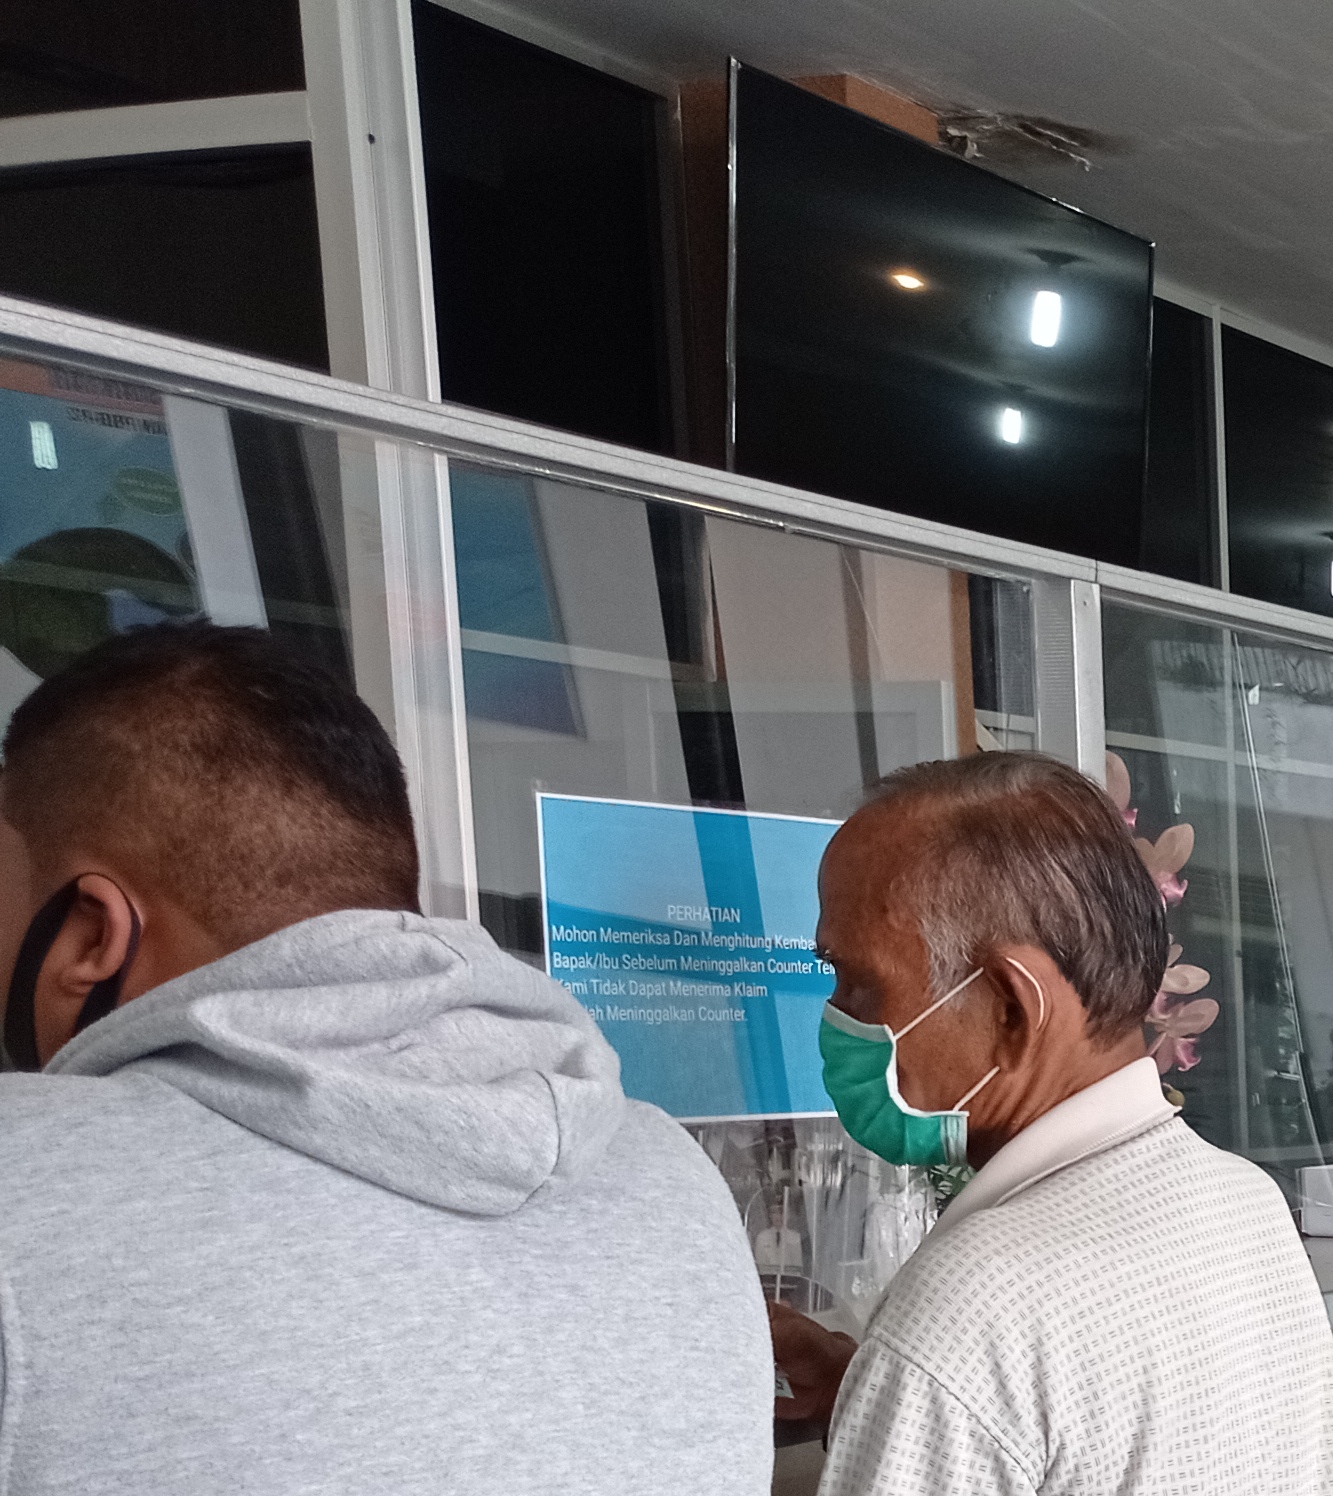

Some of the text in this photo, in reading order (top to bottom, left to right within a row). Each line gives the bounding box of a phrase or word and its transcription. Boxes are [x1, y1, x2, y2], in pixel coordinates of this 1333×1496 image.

[667, 904, 741, 923] PERHATIAN
[552, 925, 817, 952] Mohon Memeriksa Dan Menghitung Kemba
[553, 952, 619, 972] Bapak/Ibu
[622, 953, 677, 971] Sebelum
[681, 955, 765, 976] Meninggalkan
[767, 958, 813, 974] Counter
[558, 978, 768, 999] ami Tidak Dapat Menerima Klaim
[606, 1005, 695, 1024] Meninggalkan
